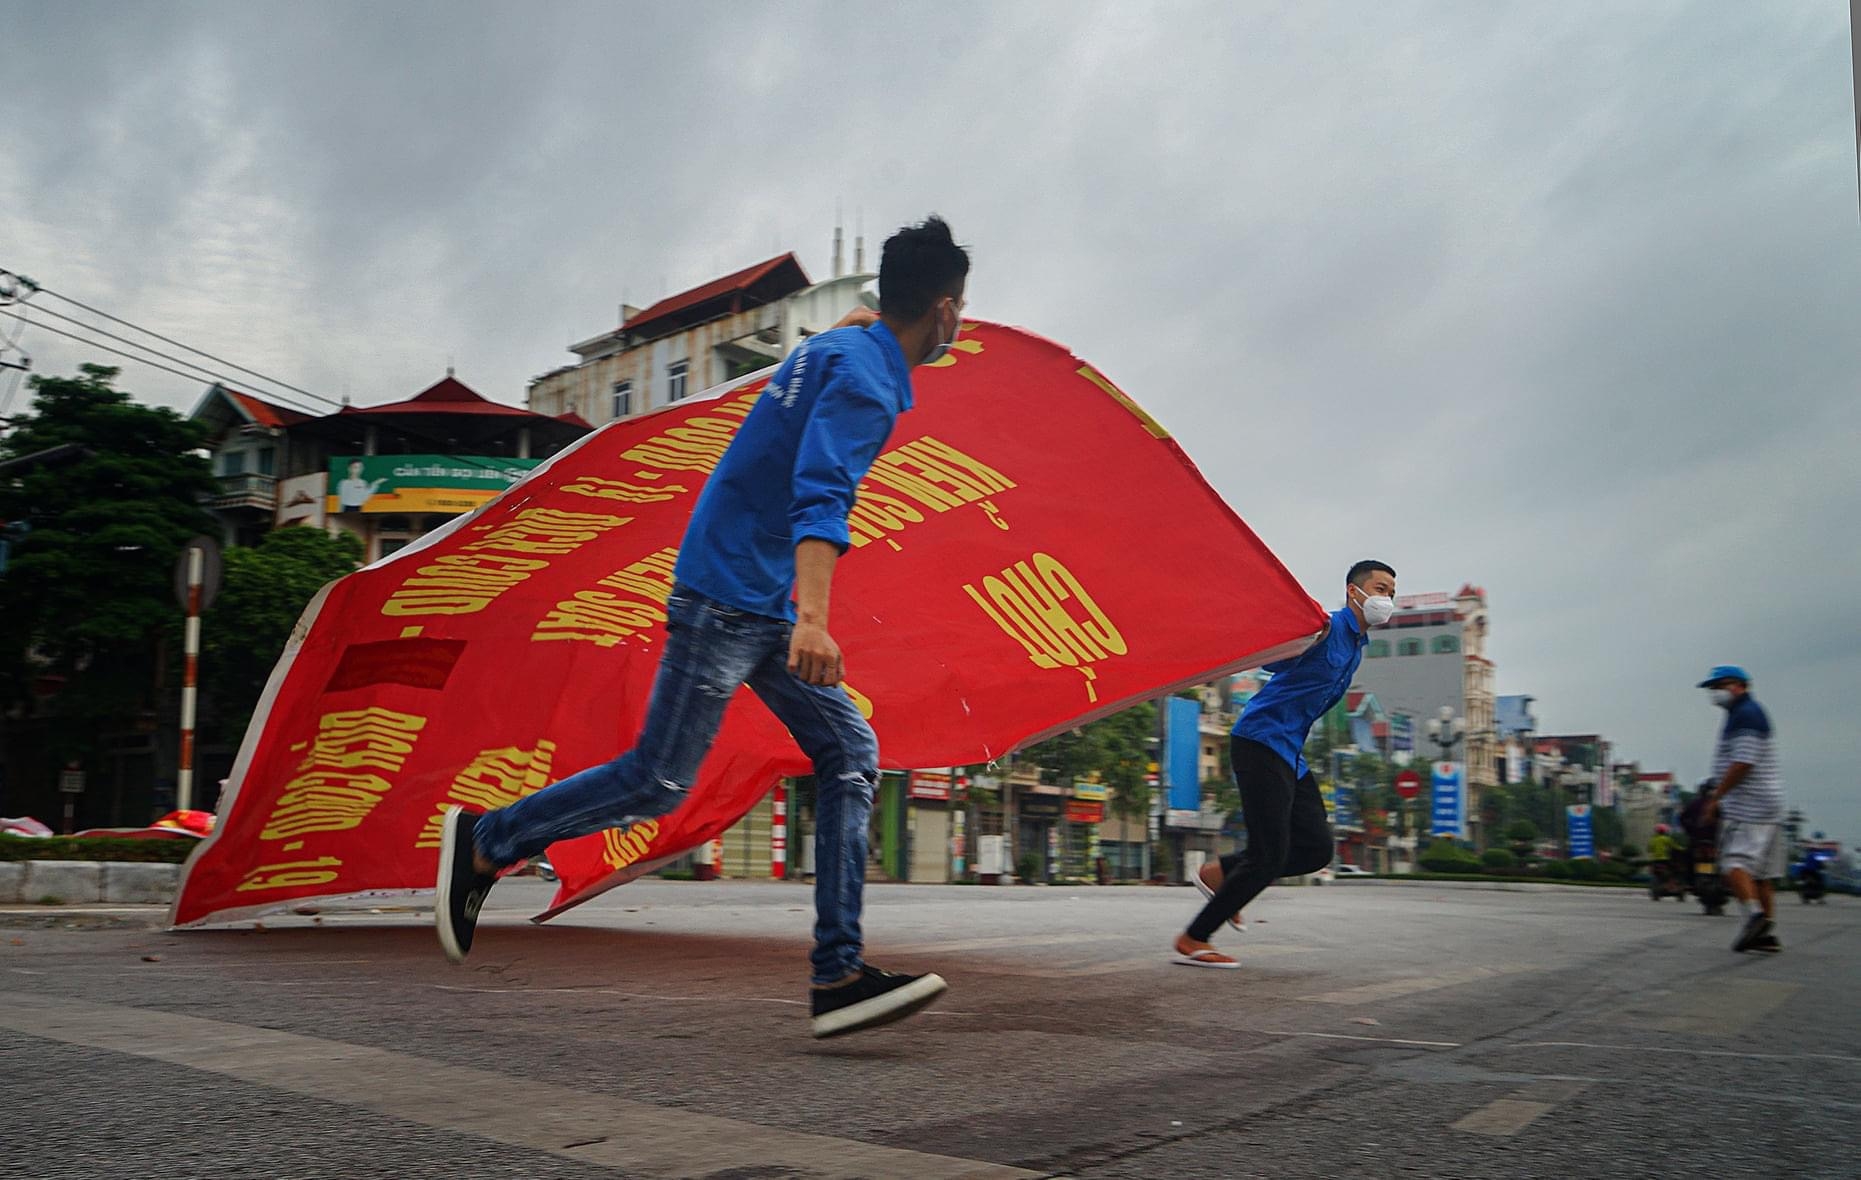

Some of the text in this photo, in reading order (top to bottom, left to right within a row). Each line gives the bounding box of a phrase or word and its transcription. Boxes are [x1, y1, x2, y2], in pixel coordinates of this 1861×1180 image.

[560, 476, 688, 503] 19
[381, 554, 550, 616] COVID
[530, 590, 667, 647] SOÁT
[964, 552, 1127, 703] CHỐT
[258, 772, 393, 840] COVID
[235, 856, 343, 891] 19
